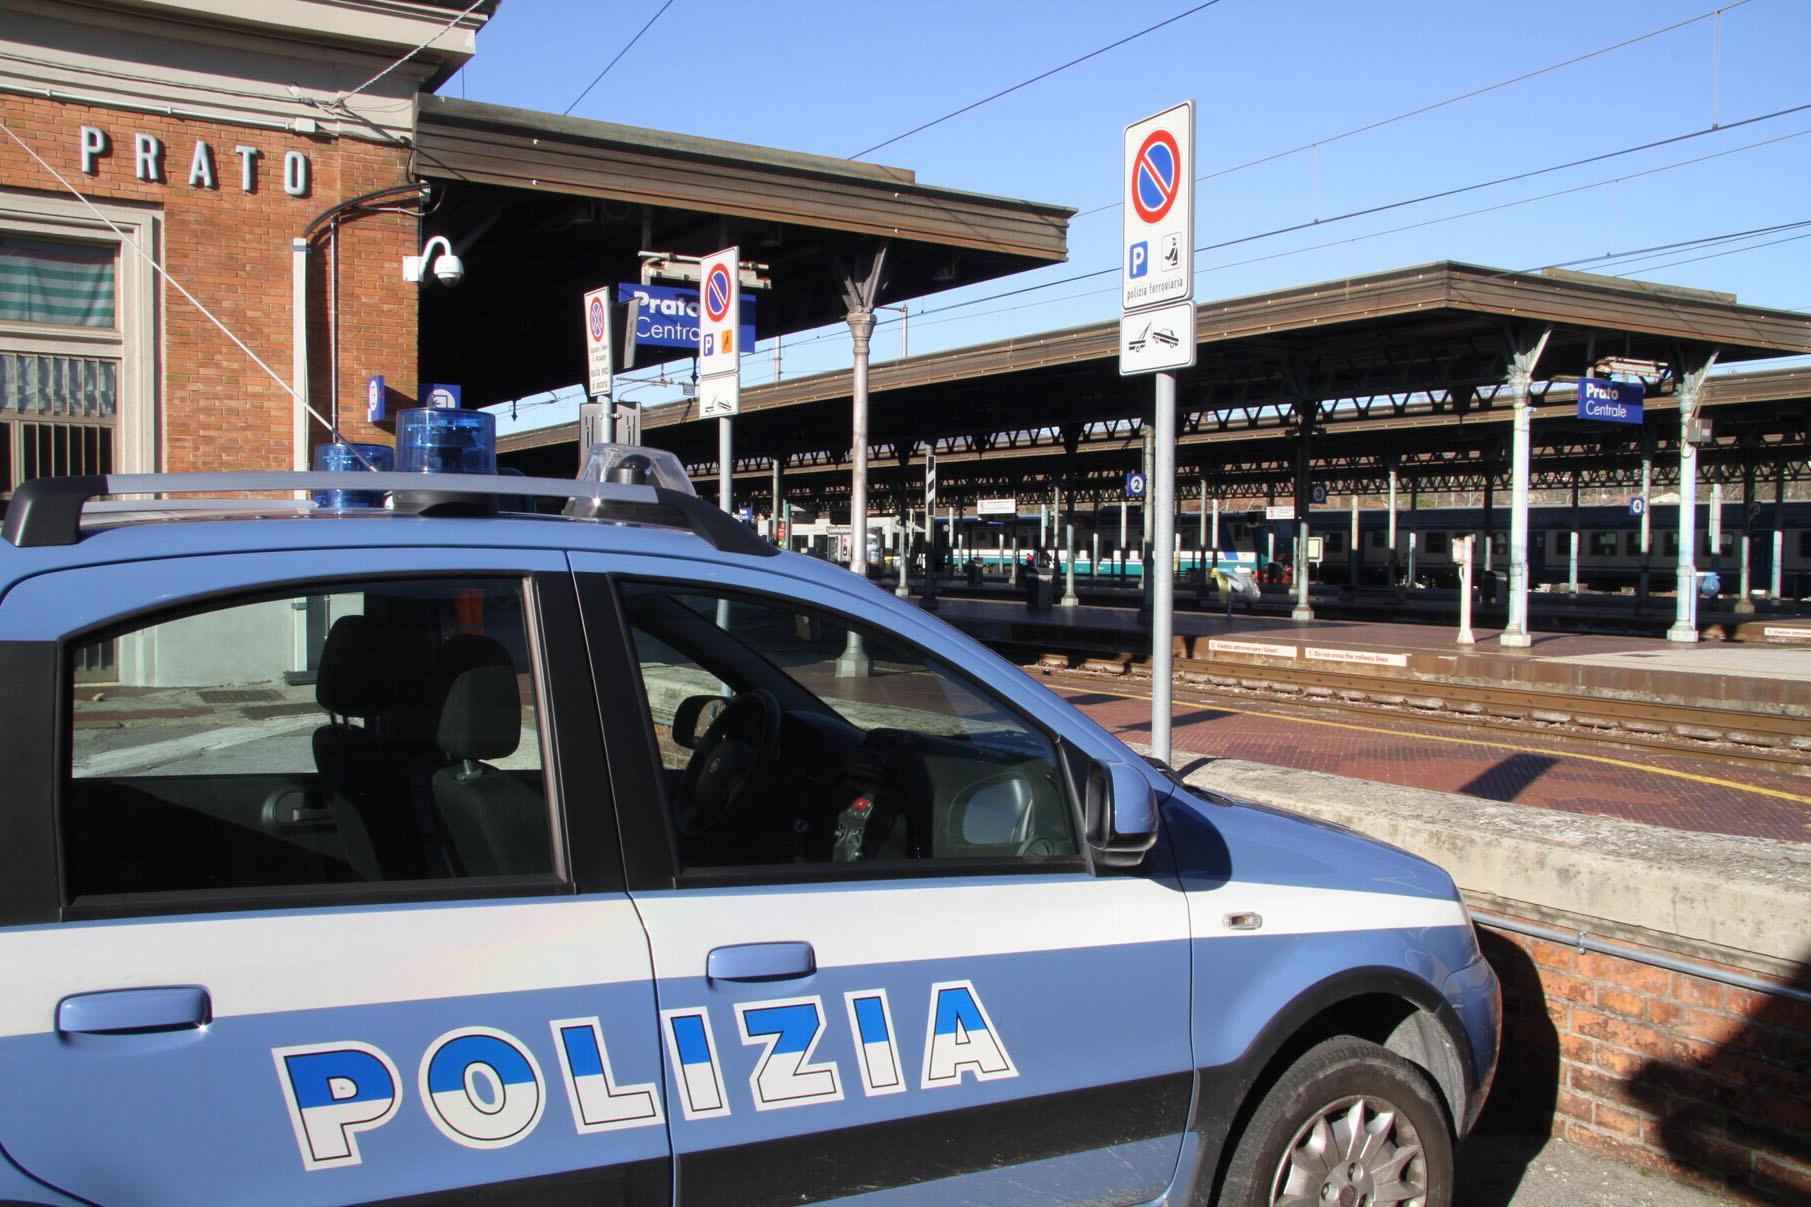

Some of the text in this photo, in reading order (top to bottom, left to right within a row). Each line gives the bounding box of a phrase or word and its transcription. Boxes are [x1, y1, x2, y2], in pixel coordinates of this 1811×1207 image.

[81, 126, 306, 195] PRATO
[1133, 246, 1144, 275] P
[1127, 278, 1183, 302] polizia ferroviaria
[633, 290, 700, 317] Prato
[636, 316, 700, 341] Centra
[705, 335, 712, 355] P
[1586, 383, 1619, 399] Prato
[1586, 401, 1627, 417] Centrale
[272, 979, 1019, 1172] POLIZIA
